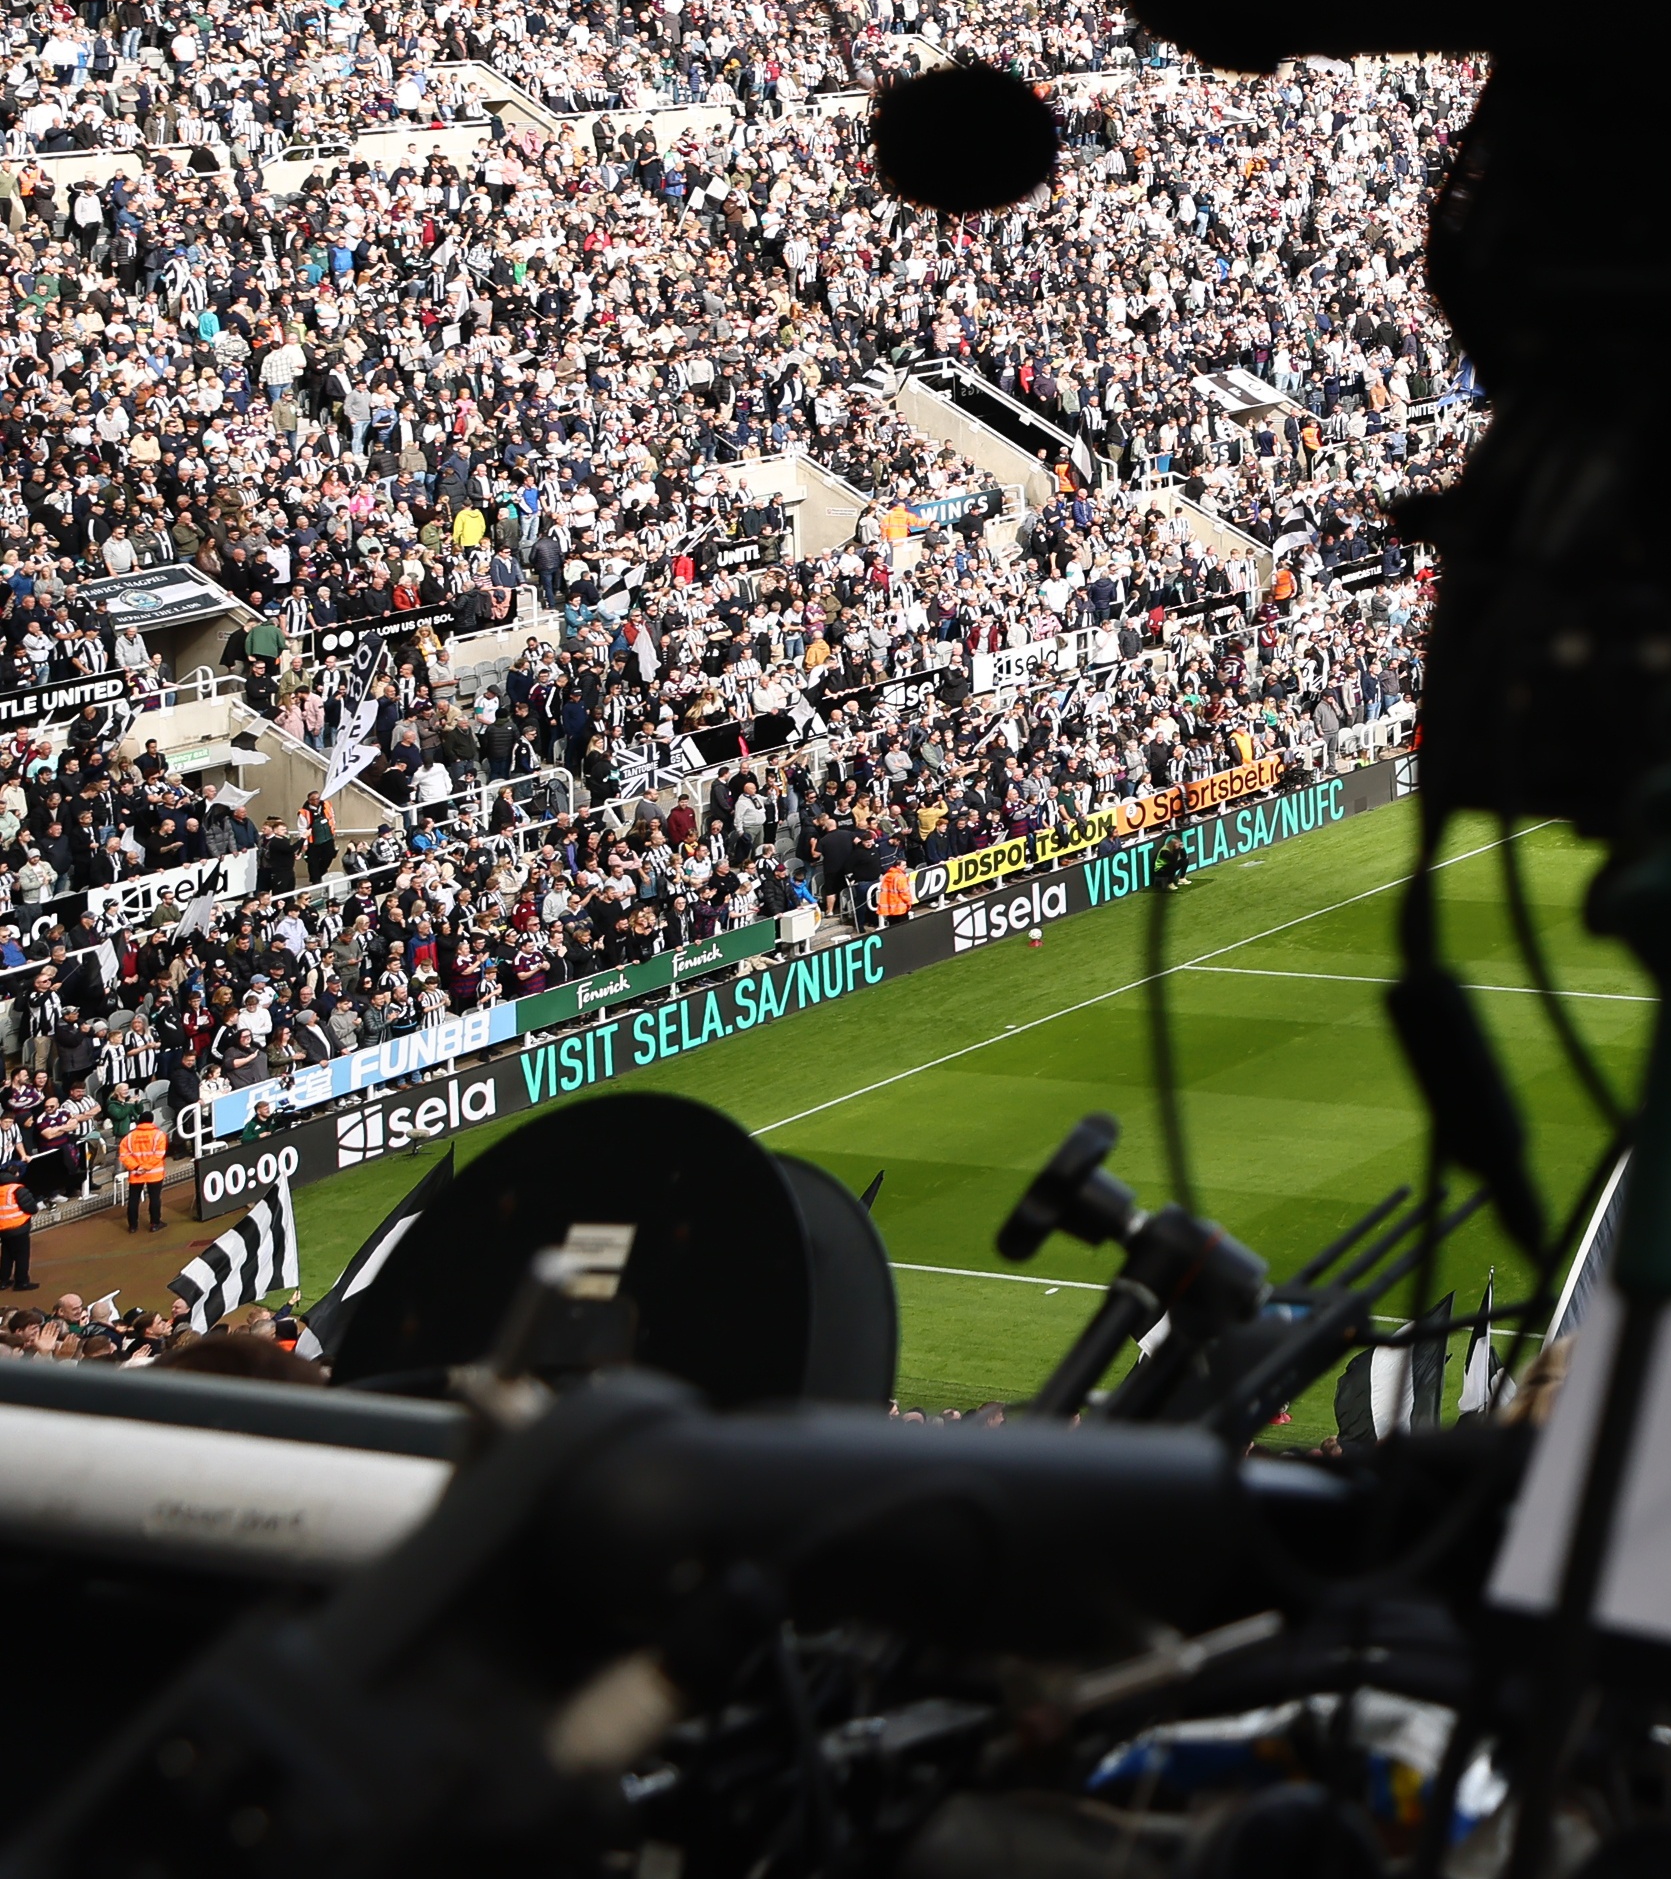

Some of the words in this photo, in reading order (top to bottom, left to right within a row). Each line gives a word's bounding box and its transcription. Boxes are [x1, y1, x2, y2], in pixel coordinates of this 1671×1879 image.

[920, 495, 989, 522] WINGS
[717, 544, 761, 567] UNITE
[401, 620, 416, 632] US
[42, 679, 124, 711] UNITED
[138, 676, 159, 692] 10
[622, 760, 659, 778] TANTOBIE
[918, 868, 947, 899] JD
[1084, 841, 1154, 906] VISIT
[990, 882, 1067, 938] sela
[672, 943, 723, 978] Fenwick
[576, 973, 631, 1010] Fenwick
[520, 1023, 620, 1104] VISIT
[633, 934, 884, 1066] SELA.SA/NUFC
[351, 1010, 490, 1089] FUN88
[388, 1078, 497, 1148] sela
[203, 1145, 299, 1203] 00:00
